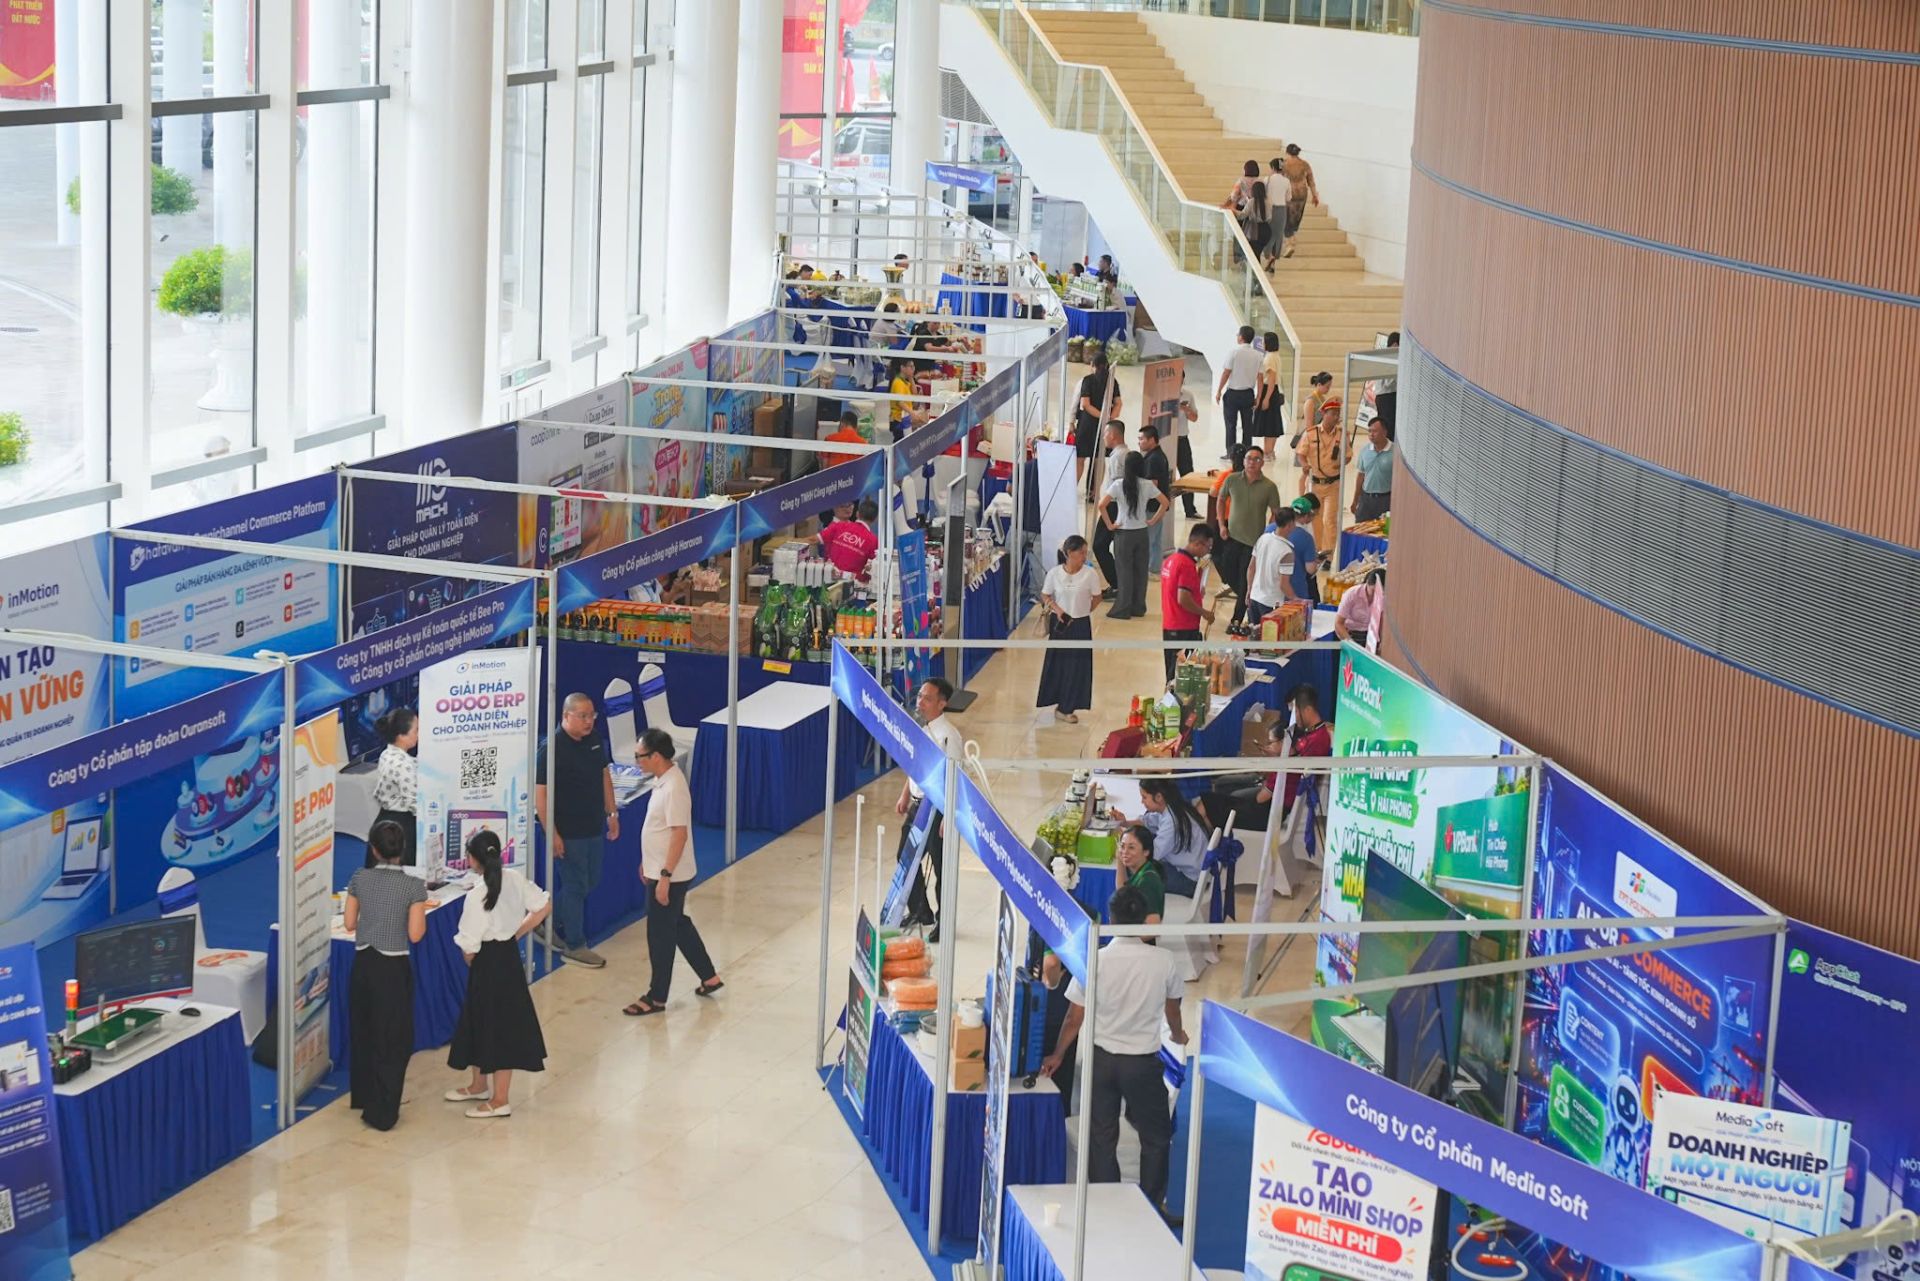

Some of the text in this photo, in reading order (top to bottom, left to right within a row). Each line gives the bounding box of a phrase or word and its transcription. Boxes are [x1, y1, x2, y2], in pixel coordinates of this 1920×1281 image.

[250, 510, 292, 532] Commerce
[293, 501, 326, 520] Platform
[416, 504, 448, 524] MACHI
[402, 533, 419, 549] PHÁP
[419, 527, 438, 545] QUẢN
[446, 520, 463, 535] TOÀN
[418, 540, 440, 555] DOANH
[440, 532, 464, 550] NGHIỆP
[602, 534, 702, 580] Công ty Cổ phần công nghệ Haravan
[8, 582, 59, 608] inMotion
[337, 601, 505, 670] Công ty TNHH dịch vụ Kế toán quốc tế Bee Pro
[17, 645, 55, 675] TẠO
[350, 623, 494, 686] và Công ty cổ phần Công nghệ InMotion
[472, 660, 506, 670] inMotion
[19, 670, 84, 710] VỮNG
[436, 692, 526, 714] ODOO ERP
[450, 680, 512, 697] GIẢI PHÁP
[1354, 672, 1382, 712] VPBank
[432, 718, 527, 736] CHO DOANH NGHIỆP
[452, 710, 509, 724] TOÀN DIỆN
[48, 710, 226, 789] Công ty Cổ phần tập đoàn Ouransoft
[308, 782, 334, 815] PRO
[1453, 830, 1478, 854] VPBank
[1622, 964, 1697, 1030] TĂNG TỐC KINH DOANH SỐ
[1632, 950, 1711, 1020] COMMERCE
[1580, 1016, 1604, 1041] CONTENT
[1572, 1099, 1599, 1127] CUSTOMER
[1346, 1094, 1389, 1133] Công
[1391, 1114, 1408, 1142] ty
[1412, 1125, 1437, 1151] Cổ
[1438, 1140, 1483, 1174] phần
[1490, 1158, 1547, 1200] Media
[1549, 1180, 1590, 1221] Soft
[1668, 1132, 1745, 1162] DOANH
[1750, 1147, 1829, 1177] NGHIỆP
[1312, 1160, 1373, 1197] TẠO
[1671, 1153, 1822, 1198] MỘT NGƯỜI
[1258, 1178, 1423, 1238] ZALO MINI SHOP
[1296, 1214, 1379, 1255] MIỄN PHÍ
[1275, 1234, 1294, 1247] hàng
[1295, 1240, 1310, 1250] trên
[1312, 1244, 1328, 1256] Zalo
[1329, 1248, 1348, 1260] dành
[1350, 1254, 1363, 1264] cho
[1364, 1259, 1387, 1271] doanh
[1388, 1266, 1414, 1280] nghiệp
